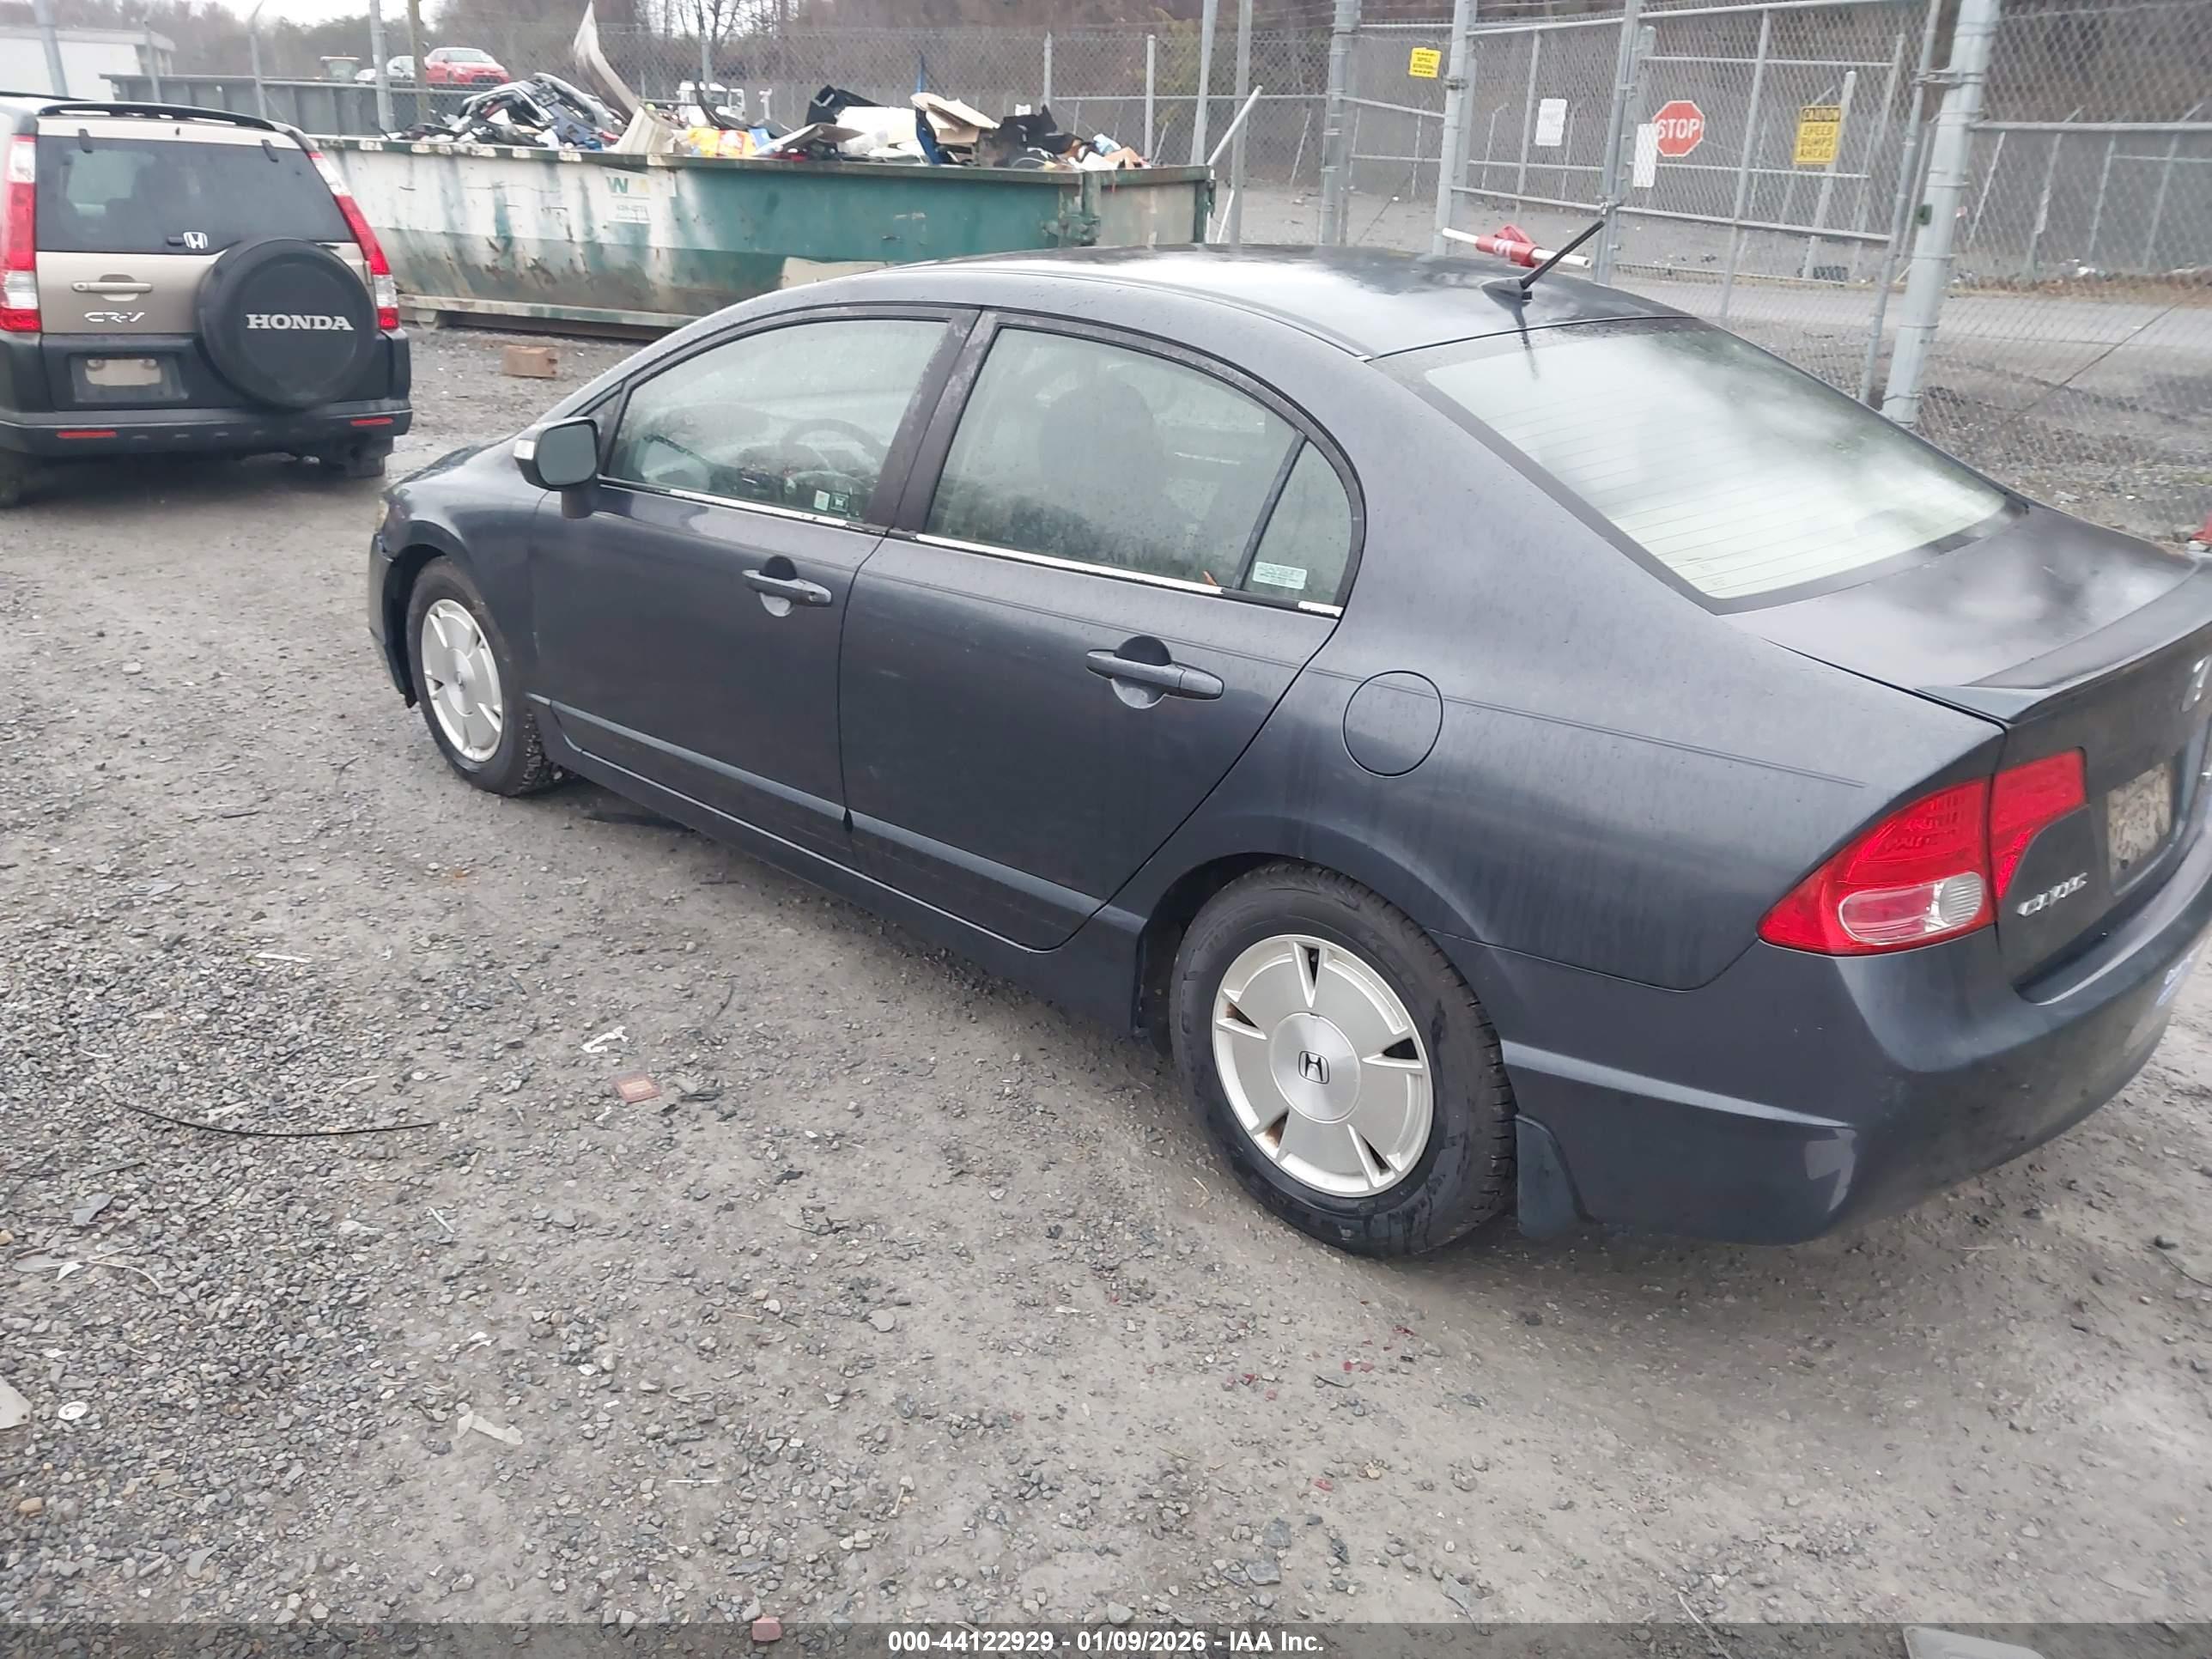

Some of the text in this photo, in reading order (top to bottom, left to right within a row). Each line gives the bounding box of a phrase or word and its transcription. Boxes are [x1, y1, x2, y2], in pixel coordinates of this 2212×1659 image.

[1656, 118, 1700, 139] STOP
[84, 311, 145, 323] CR-V
[246, 313, 355, 331] HONDA
